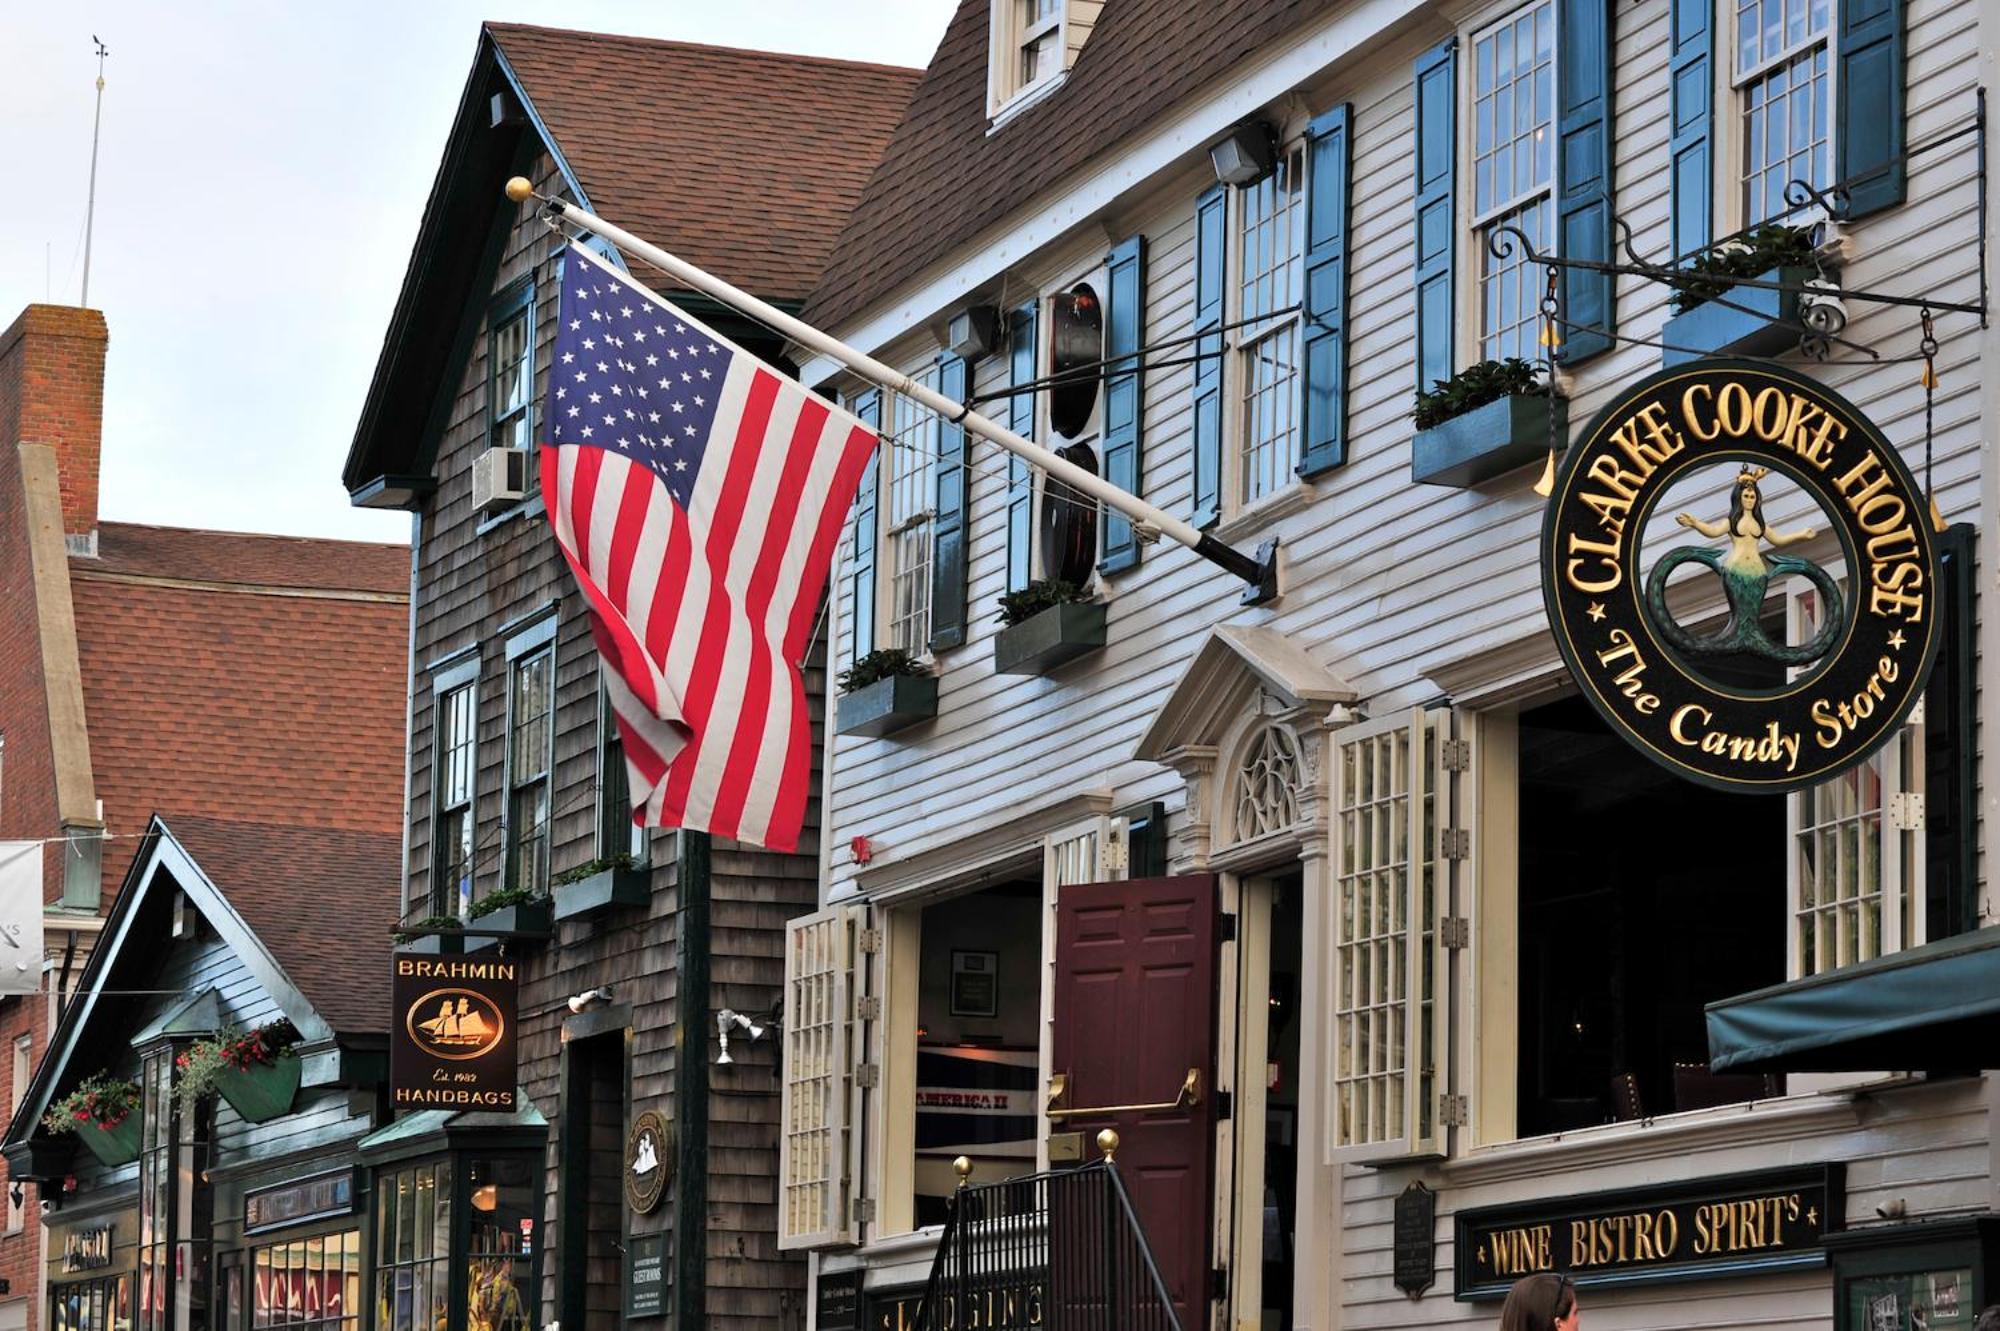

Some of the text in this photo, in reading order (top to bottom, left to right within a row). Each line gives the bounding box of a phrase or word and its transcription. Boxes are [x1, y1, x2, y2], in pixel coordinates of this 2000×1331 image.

[1566, 382, 1924, 623] CLARKE COOKE HOUSE
[1596, 628, 1899, 772] The Candy Store
[398, 960, 514, 981] BRAHMIN
[396, 1087, 512, 1105] HANDBAGS
[1490, 1225, 1553, 1277] WINE
[1569, 1209, 1679, 1269] BISTRO
